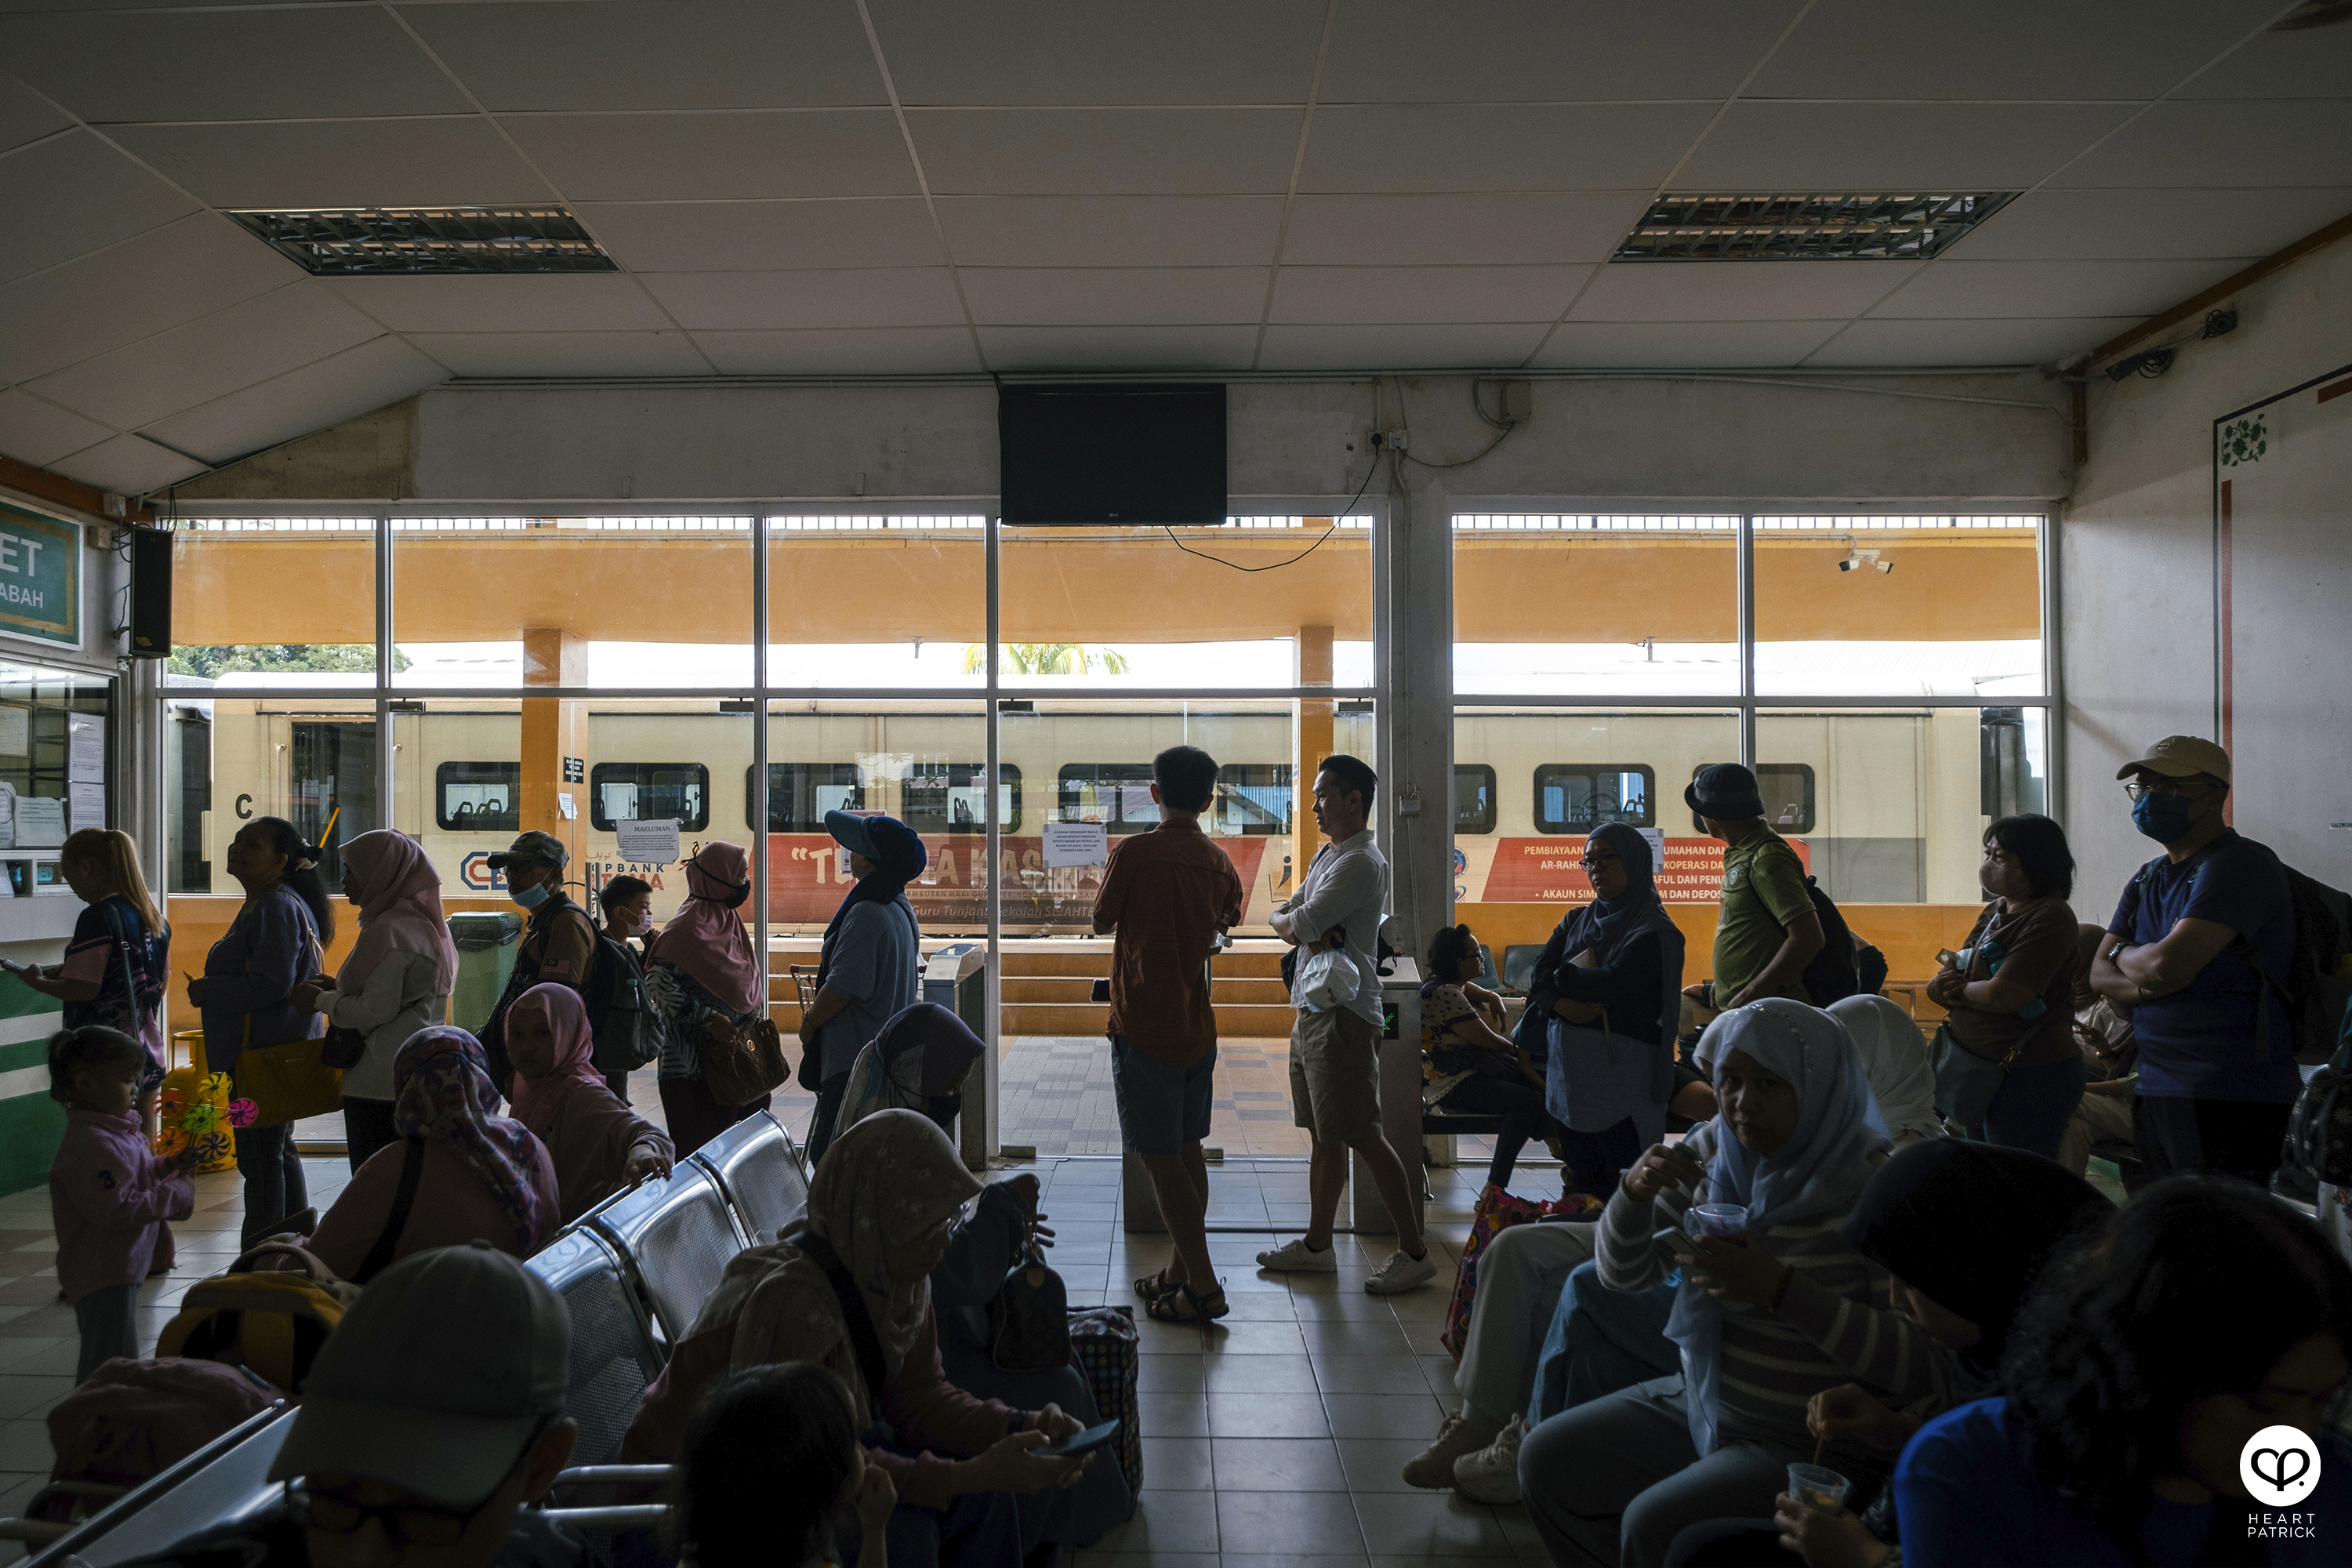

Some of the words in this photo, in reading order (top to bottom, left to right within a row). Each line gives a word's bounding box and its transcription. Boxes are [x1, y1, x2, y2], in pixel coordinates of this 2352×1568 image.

[234, 793, 253, 820] C
[1524, 846, 1584, 855] PEMBIAYAAN
[1663, 846, 1706, 855] UMAHAN
[592, 863, 664, 873] PBANK
[1663, 860, 1708, 869] KOPERASI
[1710, 860, 1724, 869] DA
[1653, 875, 1676, 884] AFUL
[1677, 875, 1697, 884] DAN
[1699, 875, 1724, 884] PENU
[1542, 889, 1576, 898] AKAUN
[1577, 889, 1598, 898] SIM
[1669, 890, 1690, 899] DAN
[1691, 890, 1721, 899] DEPOS
[913, 905, 940, 916] Guru
[1000, 905, 1043, 917] ekolah
[1044, 906, 1094, 917] SEJAHTE
[97, 1169, 116, 1190] 3
